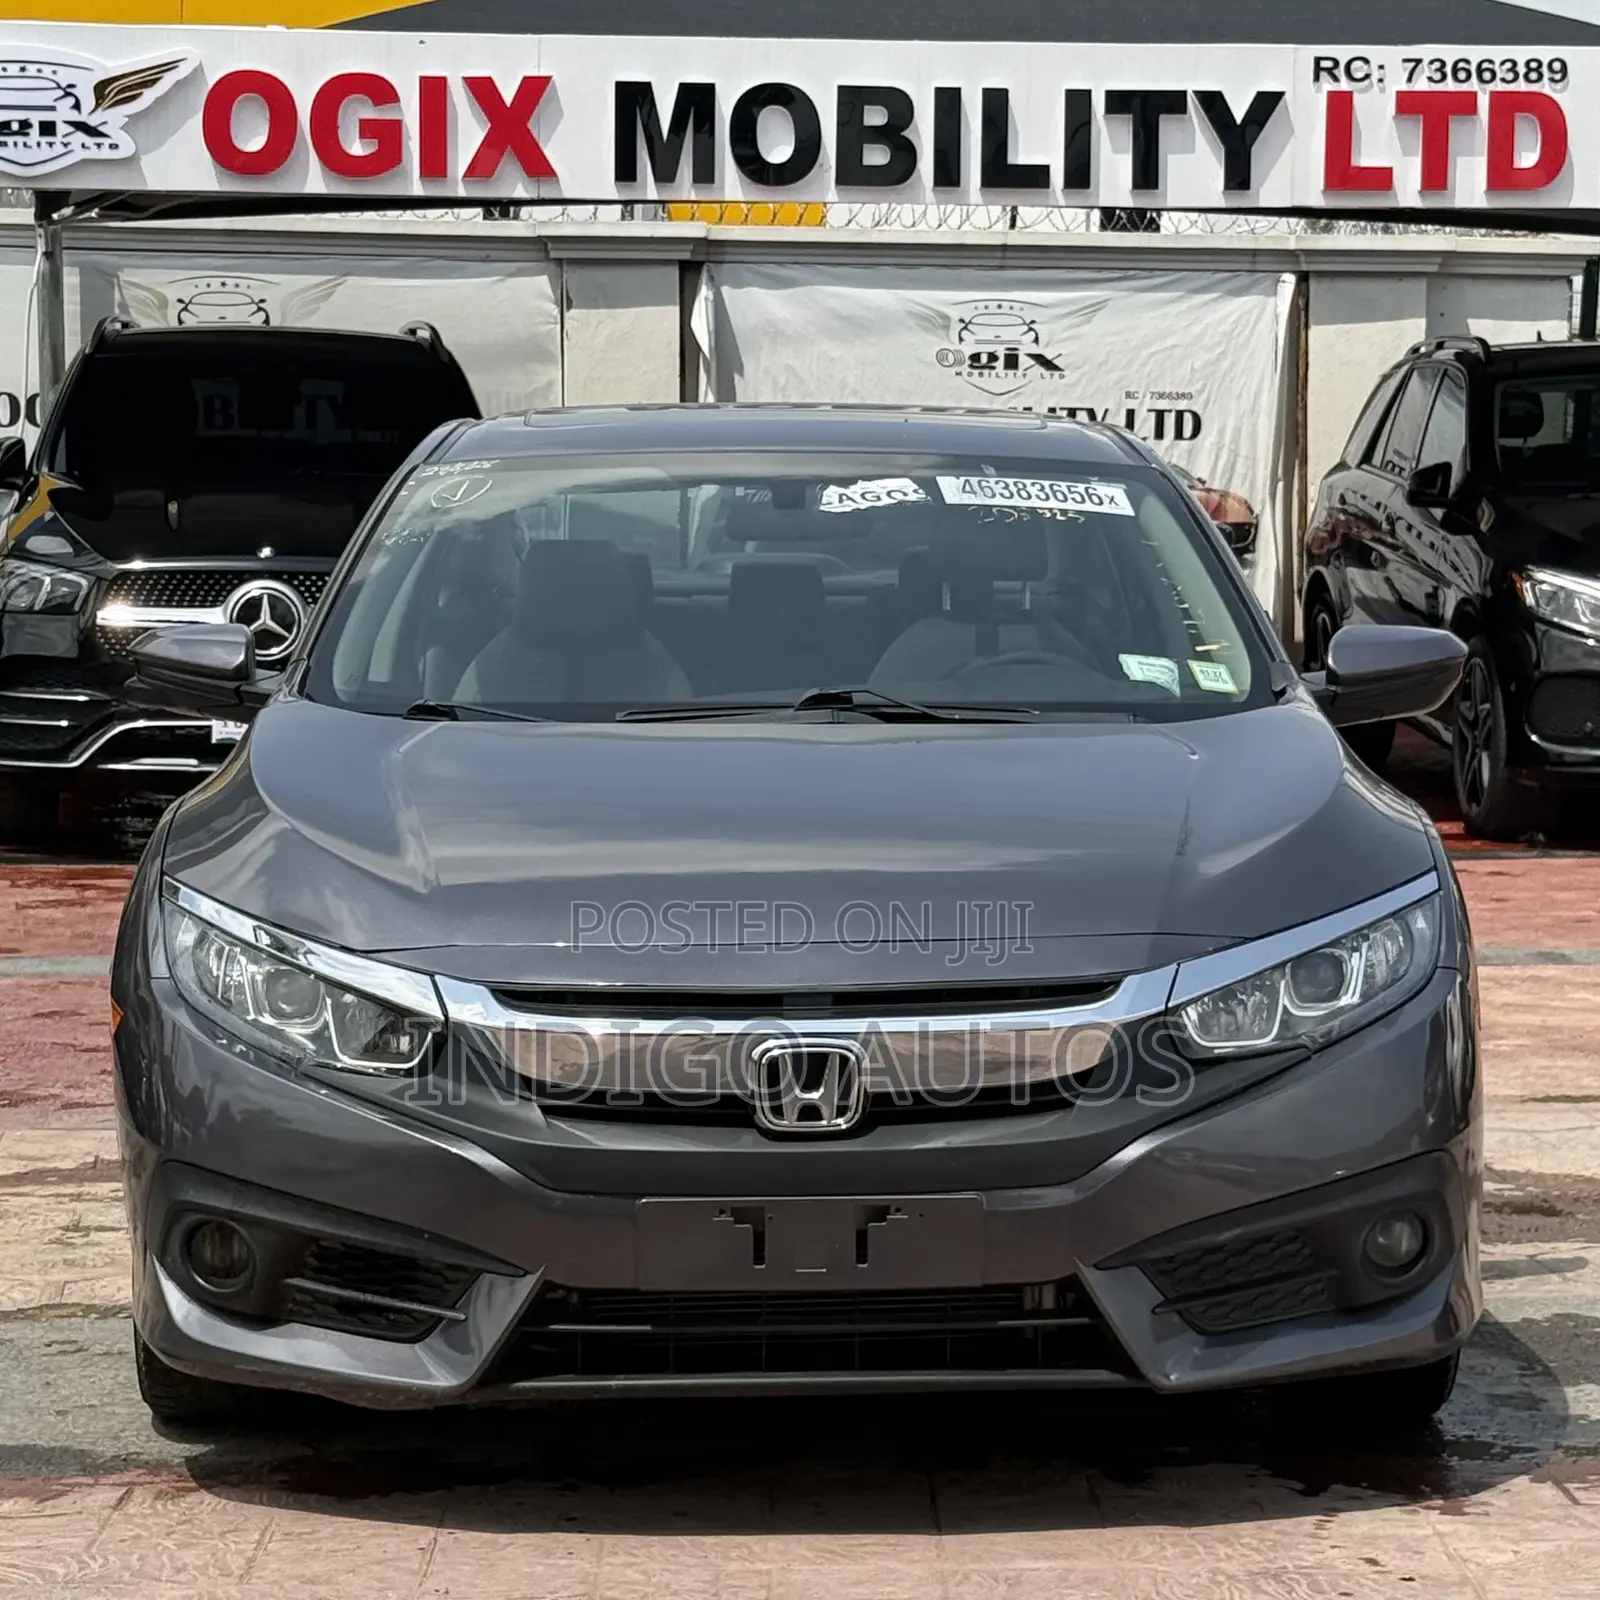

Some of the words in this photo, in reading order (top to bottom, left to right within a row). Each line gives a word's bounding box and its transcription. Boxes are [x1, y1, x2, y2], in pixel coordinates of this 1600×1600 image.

[1312, 56, 1385, 85] RC:
[1401, 56, 1569, 85] 7366389
[202, 69, 559, 180] OGIX
[614, 80, 1287, 191] MOBILITY
[1324, 90, 1569, 191] LTD
[80, 142, 120, 150] LTD
[954, 370, 1028, 379] MOBILITY
[1039, 372, 1066, 380] LTD
[1124, 390, 1140, 401] RC
[1124, 408, 1202, 442] LTD
